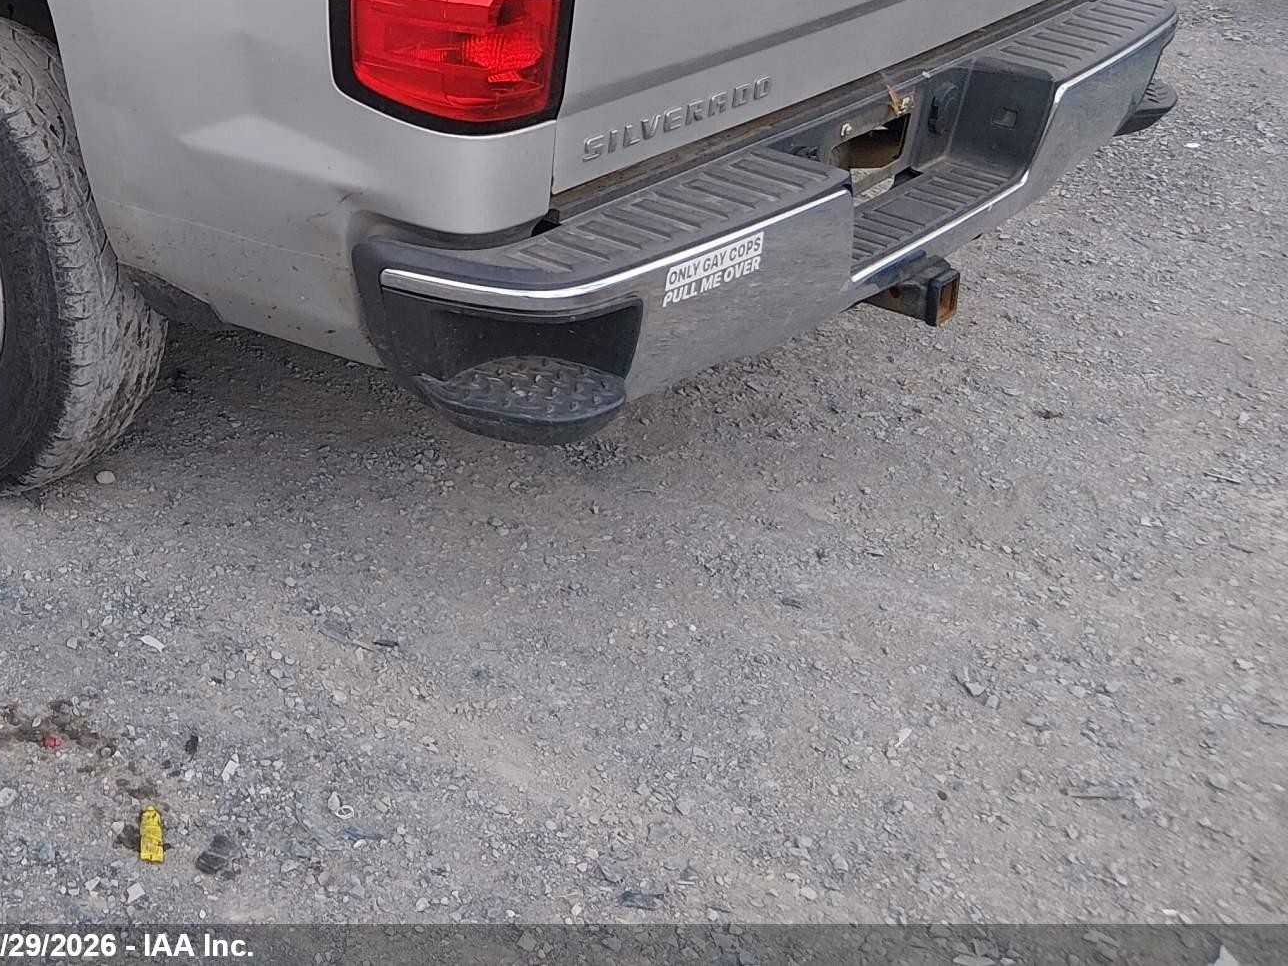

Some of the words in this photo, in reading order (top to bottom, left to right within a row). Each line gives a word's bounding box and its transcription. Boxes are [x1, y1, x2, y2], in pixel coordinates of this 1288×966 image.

[582, 75, 773, 163] SILVERADO
[663, 283, 698, 308] PULL
[700, 272, 723, 293] ME
[724, 256, 761, 283] OVER
[668, 261, 701, 285] ONLY
[703, 251, 726, 272] GAY
[729, 237, 761, 261] COPS
